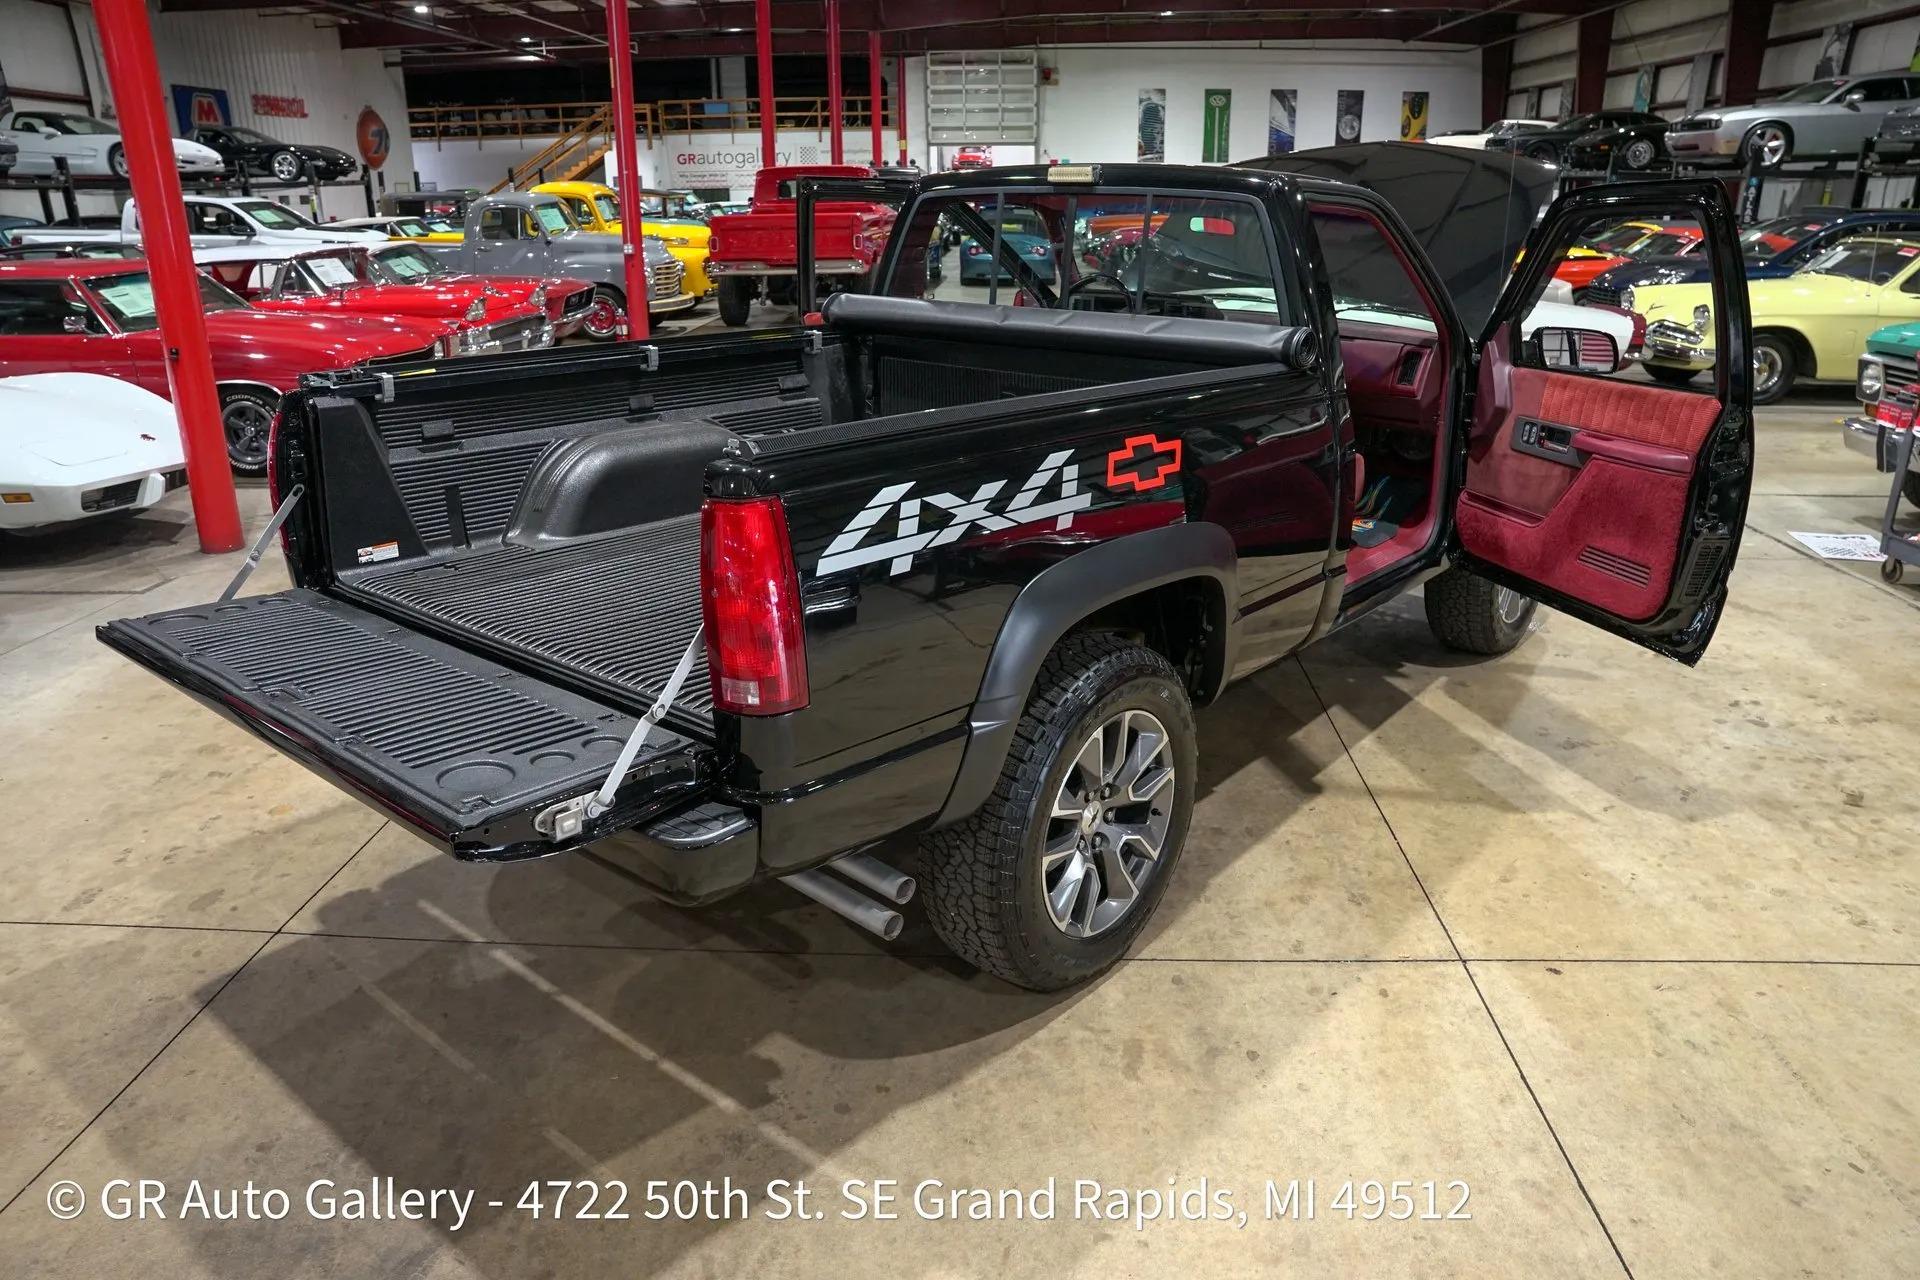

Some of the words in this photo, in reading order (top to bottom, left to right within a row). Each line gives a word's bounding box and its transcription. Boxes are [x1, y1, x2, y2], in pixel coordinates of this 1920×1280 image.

[676, 146, 792, 169] GRautogalry
[1743, 186, 1757, 223] ATLAS
[226, 394, 264, 405] COOPER
